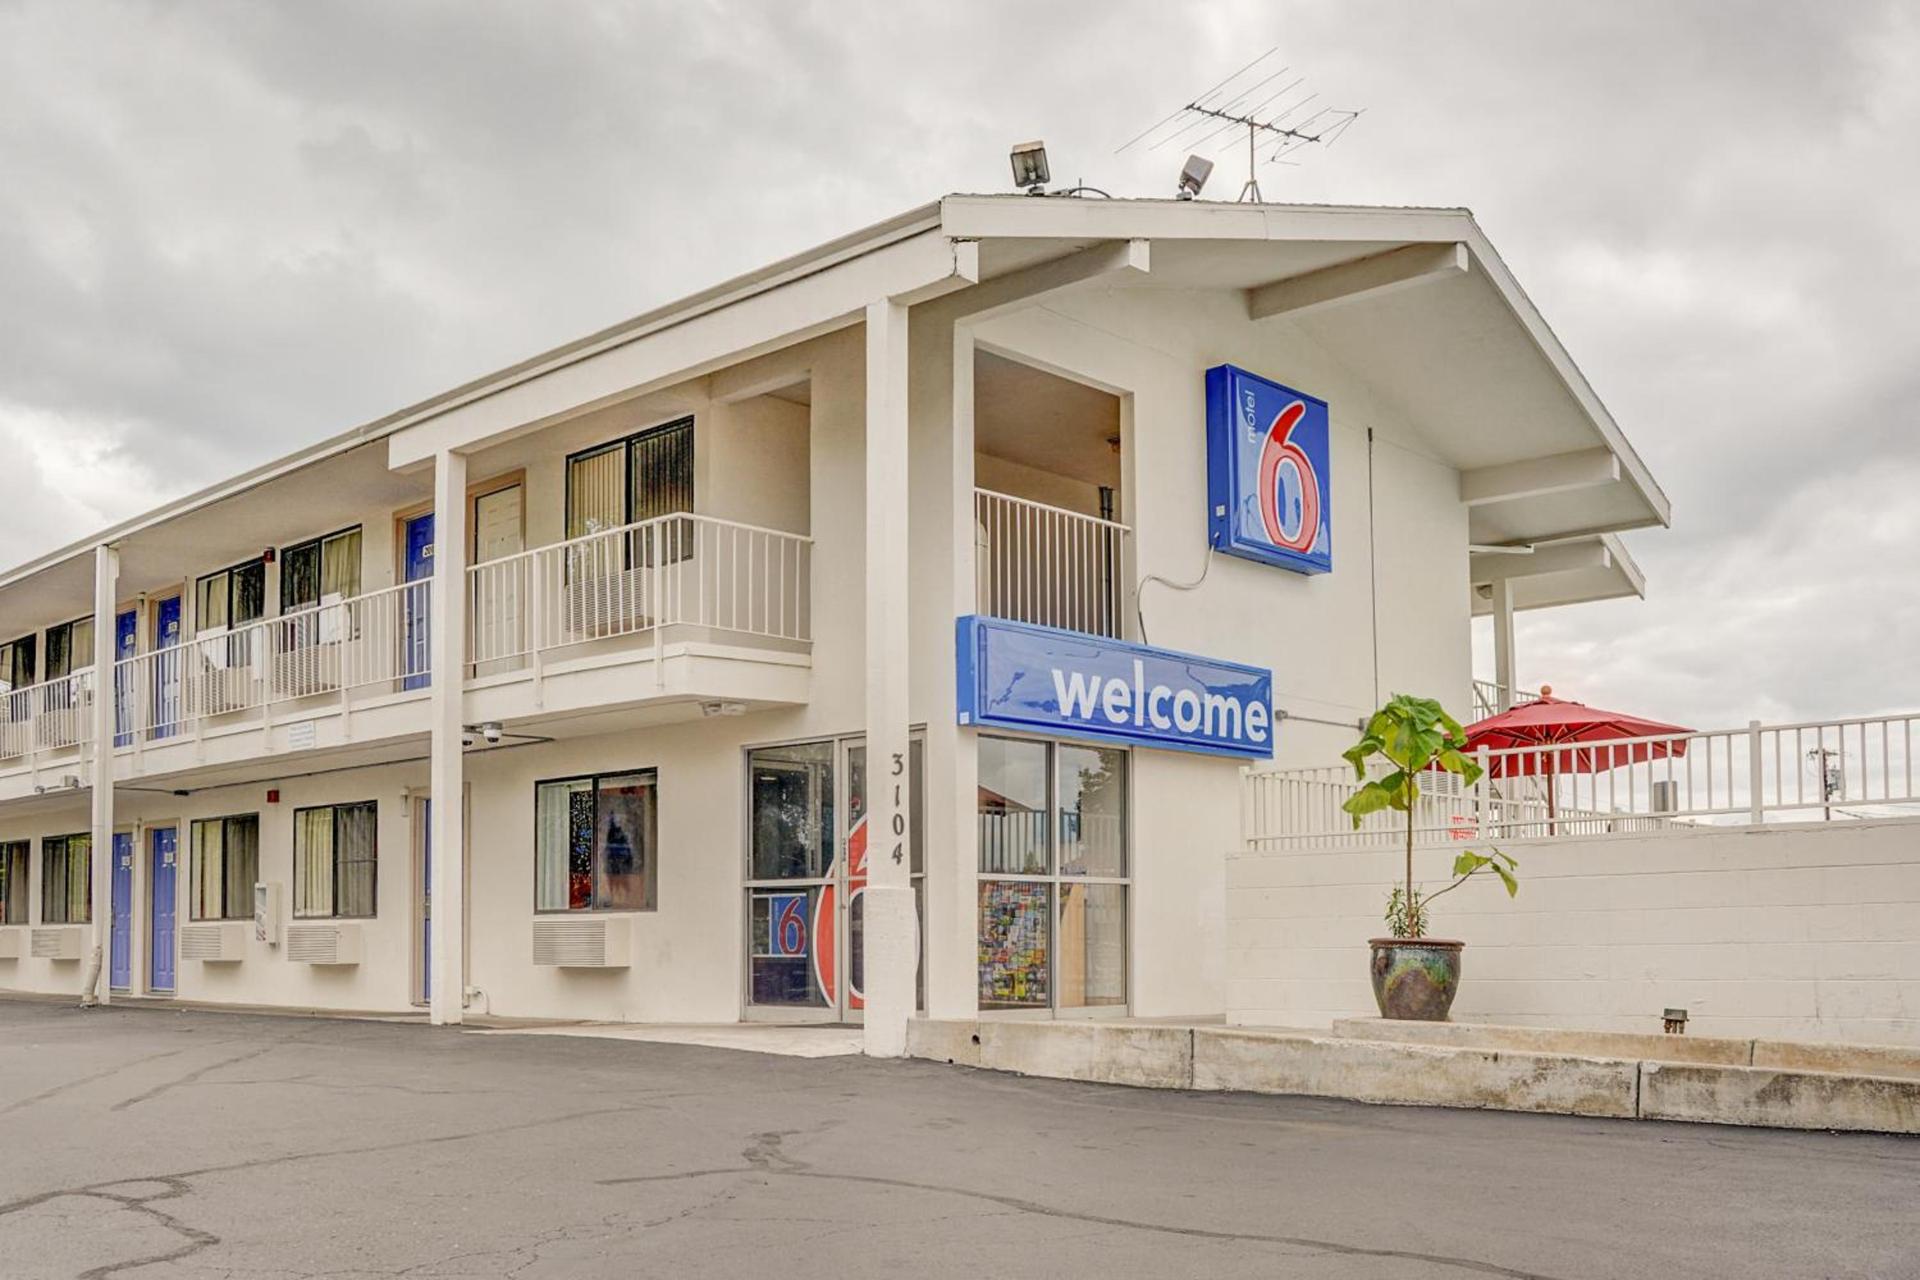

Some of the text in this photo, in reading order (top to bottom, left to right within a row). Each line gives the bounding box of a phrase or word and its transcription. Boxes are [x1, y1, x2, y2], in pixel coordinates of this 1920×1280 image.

[1245, 390, 1257, 444] motel
[1258, 400, 1320, 554] 6
[1051, 659, 1268, 743] welcome
[891, 753, 904, 865] 3104
[778, 896, 806, 955] 6
